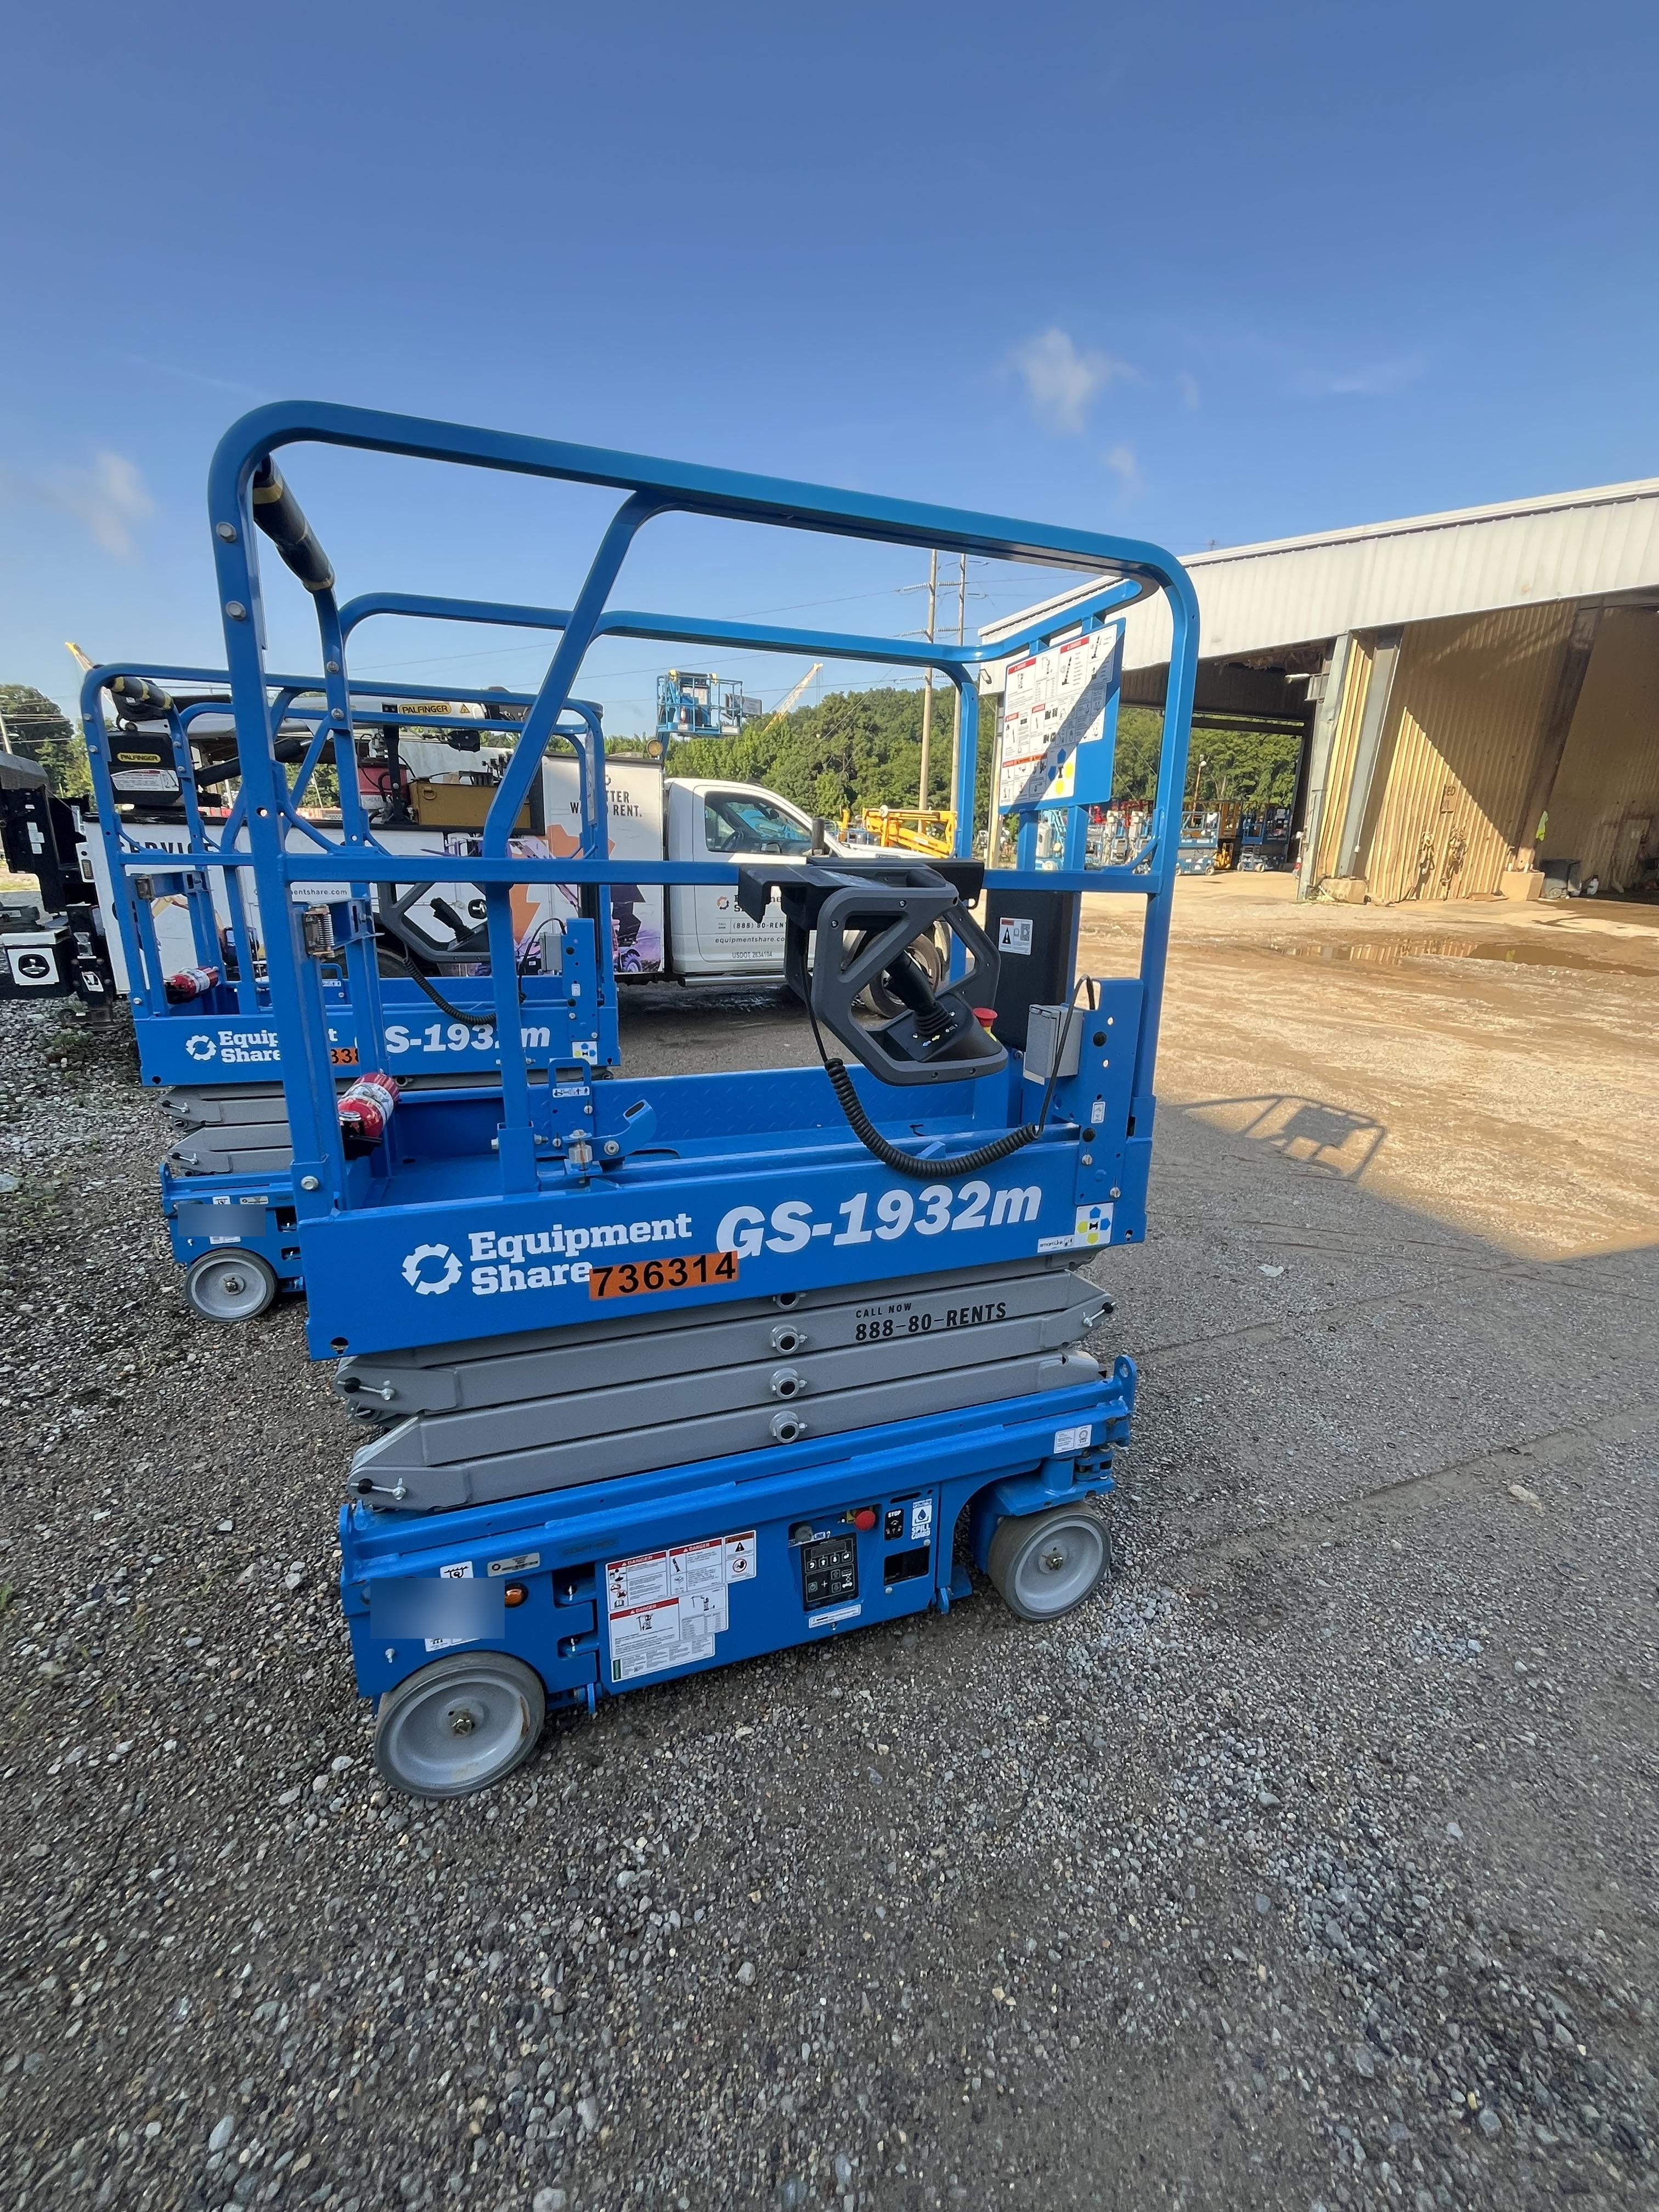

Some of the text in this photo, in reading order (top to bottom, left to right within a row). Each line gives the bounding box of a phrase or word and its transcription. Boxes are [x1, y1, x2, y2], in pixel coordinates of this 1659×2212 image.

[402, 705, 448, 713] PALFINGER
[613, 804, 642, 817] RENT.
[715, 1180, 1042, 1259] GS-1932m
[469, 1213, 692, 1263] Equipment
[471, 1262, 592, 1295] Share
[592, 1251, 736, 1297] 736314
[855, 1302, 912, 1318] CALL NOW
[855, 1302, 1006, 1341] 888-80-RENTS
[888, 1510, 901, 1518] STOP
[911, 1523, 931, 1534] SPILL
[688, 1542, 710, 1551] DANGER
[627, 1555, 653, 1565] DANGER
[635, 1604, 657, 1613] DANGER
